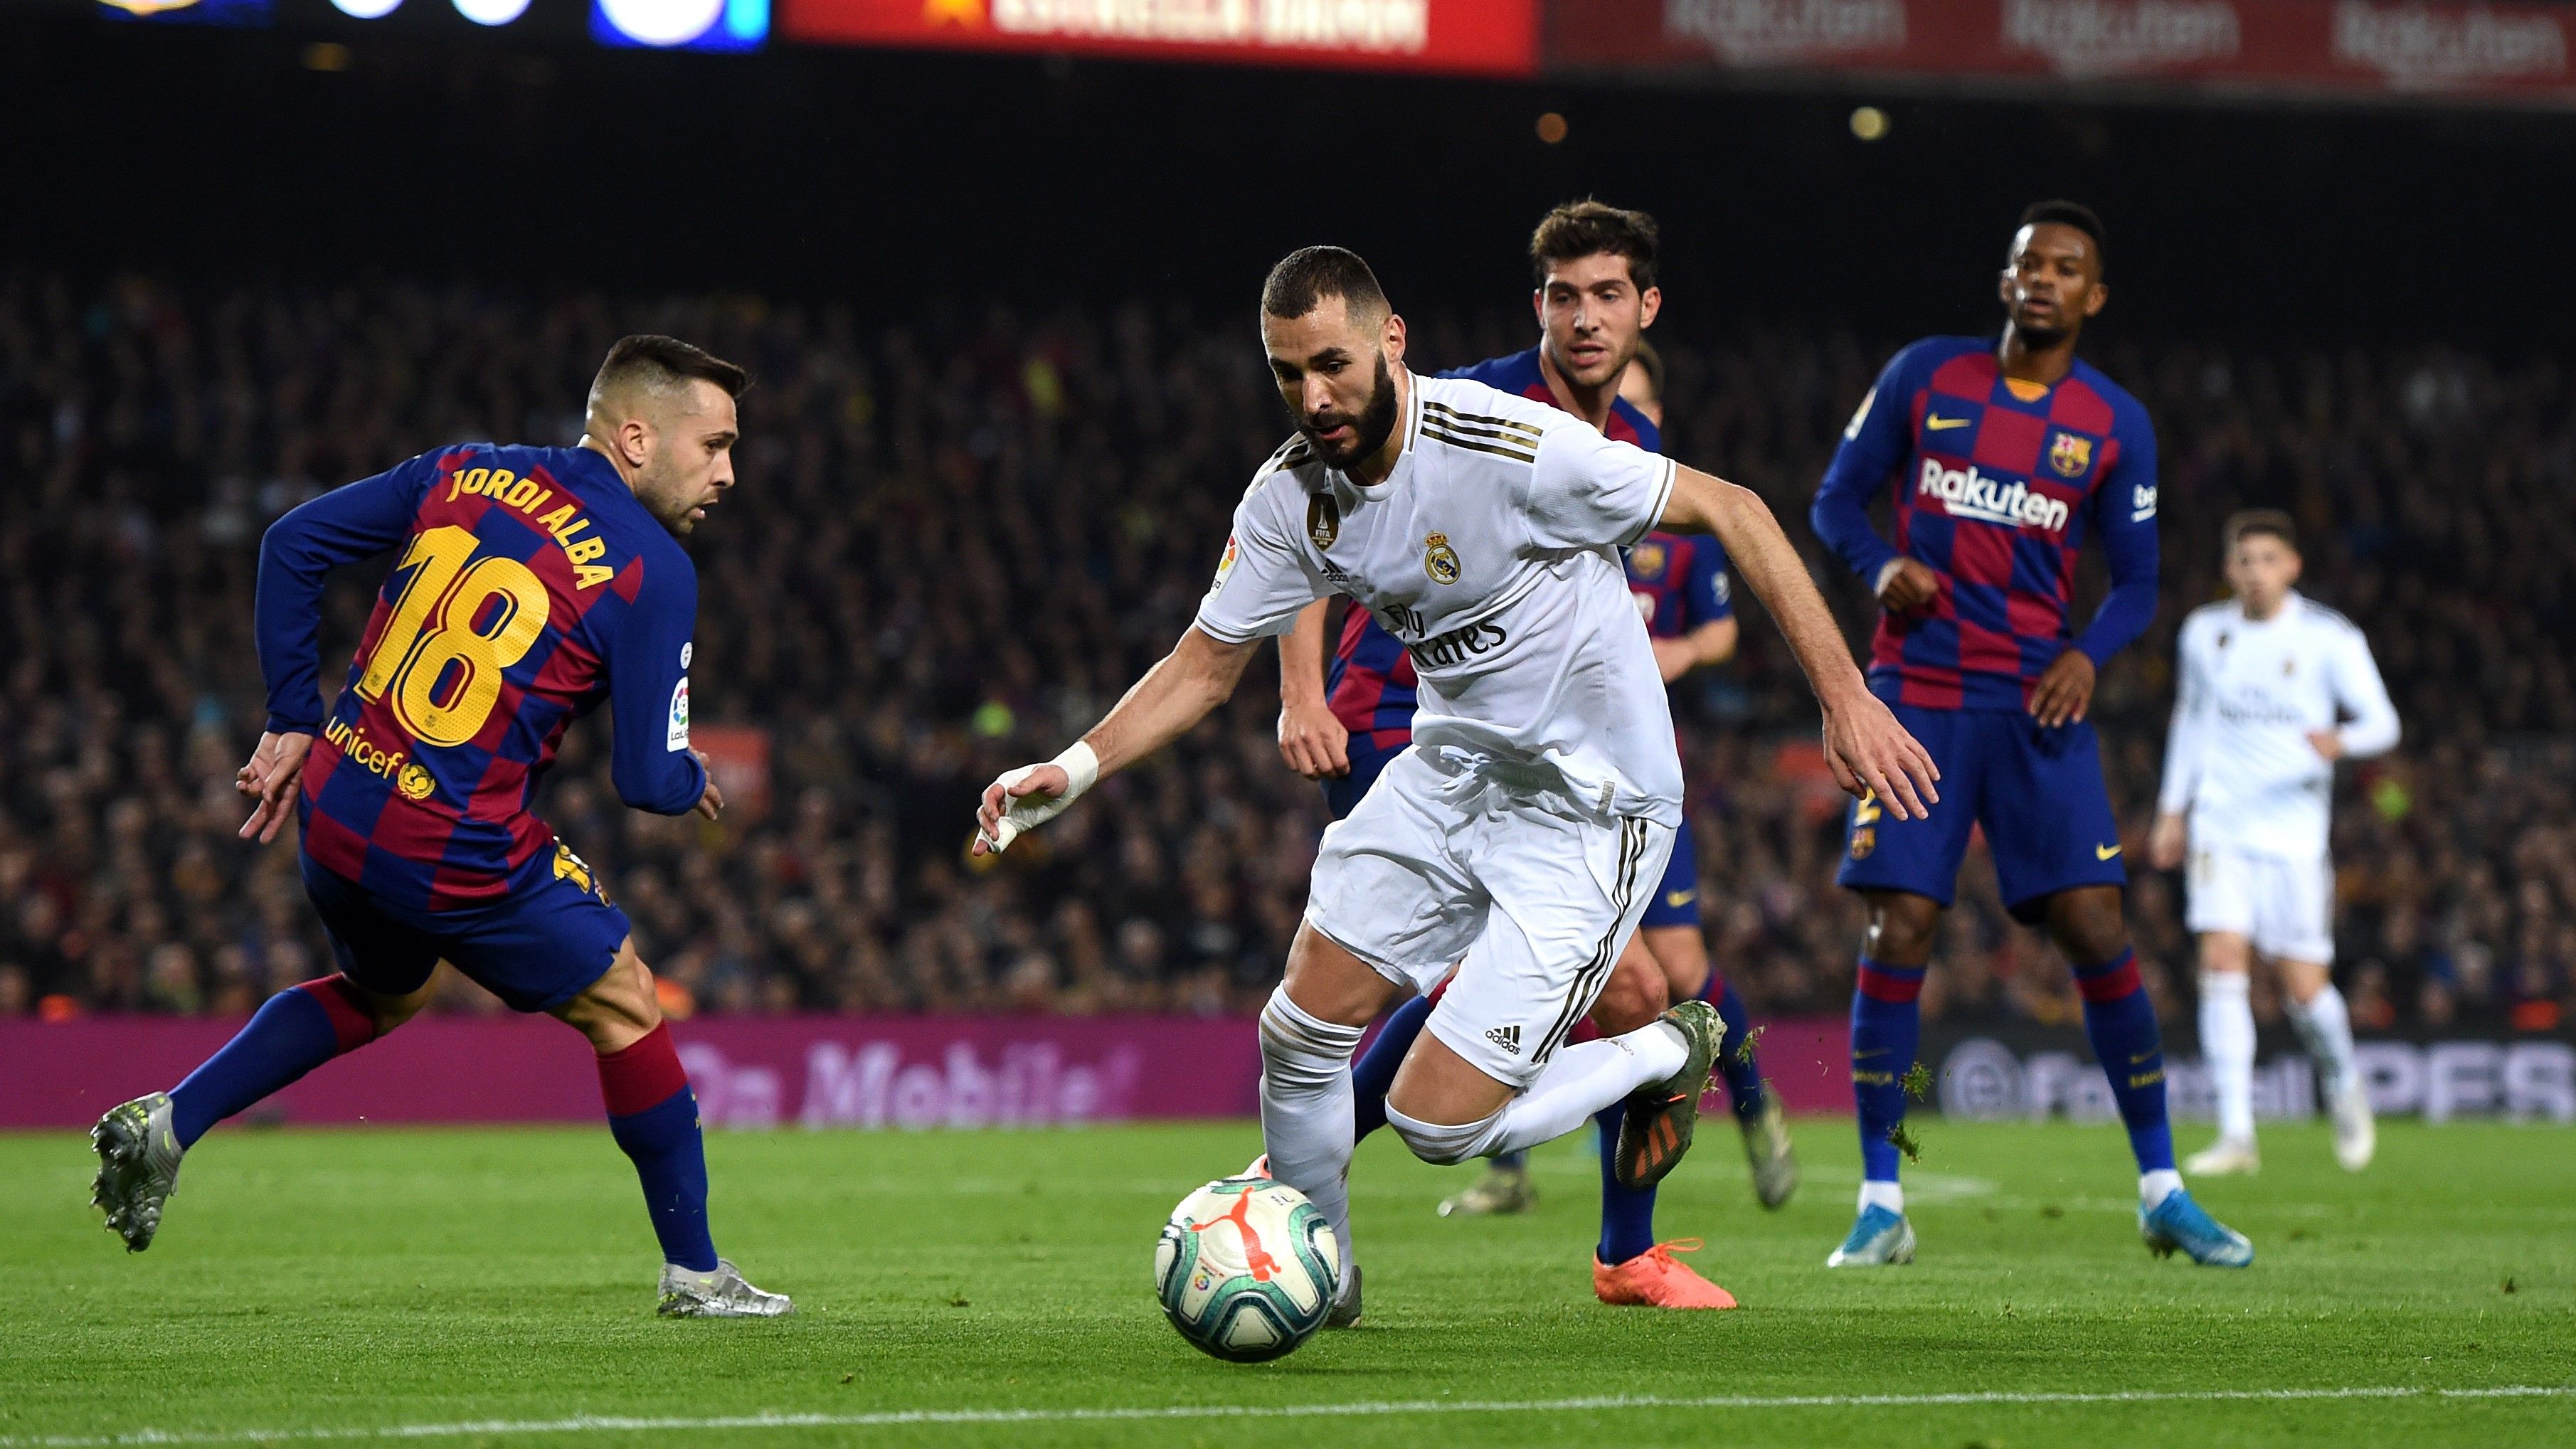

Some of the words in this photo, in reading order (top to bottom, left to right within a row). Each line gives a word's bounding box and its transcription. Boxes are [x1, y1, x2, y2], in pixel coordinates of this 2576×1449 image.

[445, 467, 552, 515] JORDI
[536, 504, 615, 591] ALBA
[1919, 457, 2069, 533] Rakuten
[1315, 529, 1331, 538] FIFA
[353, 524, 551, 748] 18
[1380, 603, 1426, 639] Fly
[324, 716, 404, 780] unicef
[1485, 1029, 1521, 1056] adidas
[2353, 1041, 2575, 1124] PES
